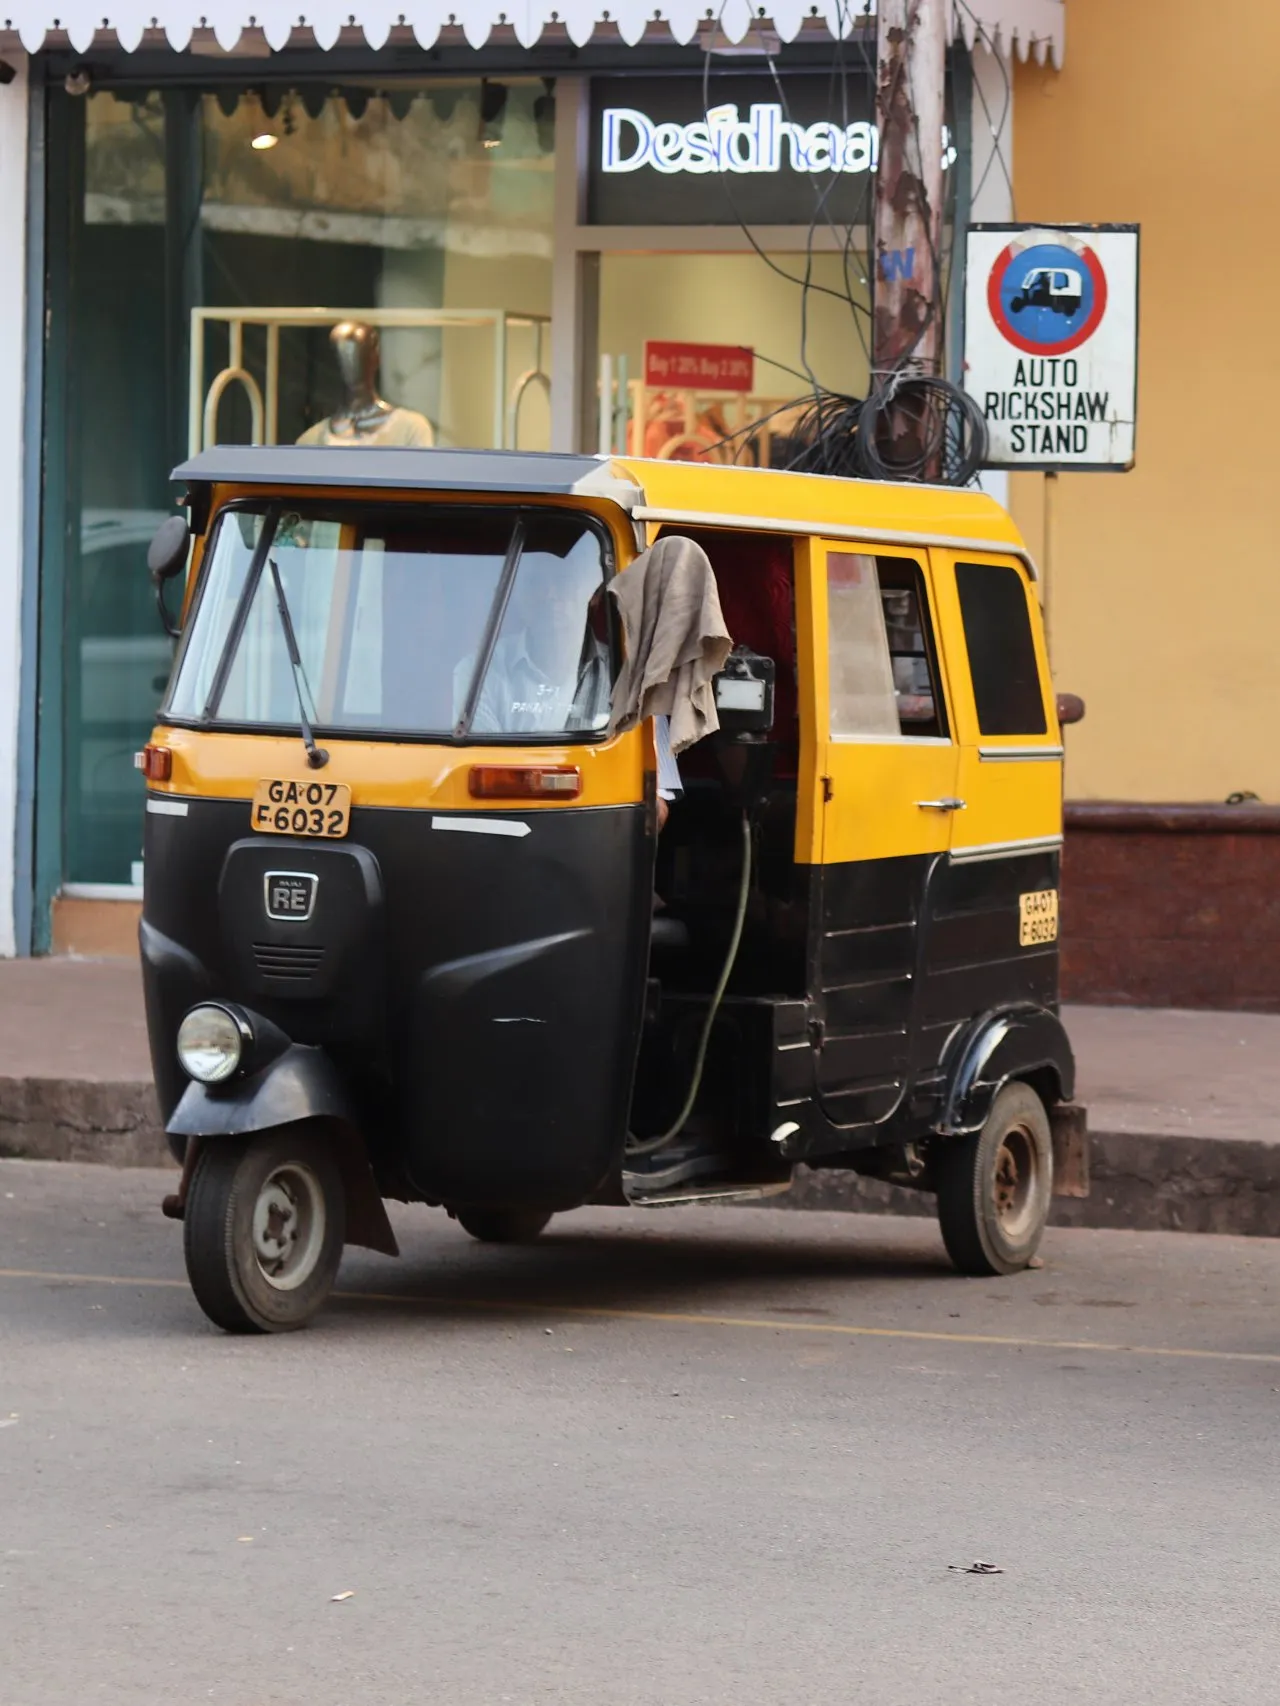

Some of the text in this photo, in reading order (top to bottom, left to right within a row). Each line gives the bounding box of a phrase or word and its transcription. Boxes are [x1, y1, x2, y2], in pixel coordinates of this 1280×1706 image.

[602, 103, 957, 173] Desidhaa
[1013, 358, 1078, 387] AUTO
[984, 391, 1109, 421] RICKSHAW
[1010, 424, 1088, 453] STAND
[273, 887, 307, 911] RE
